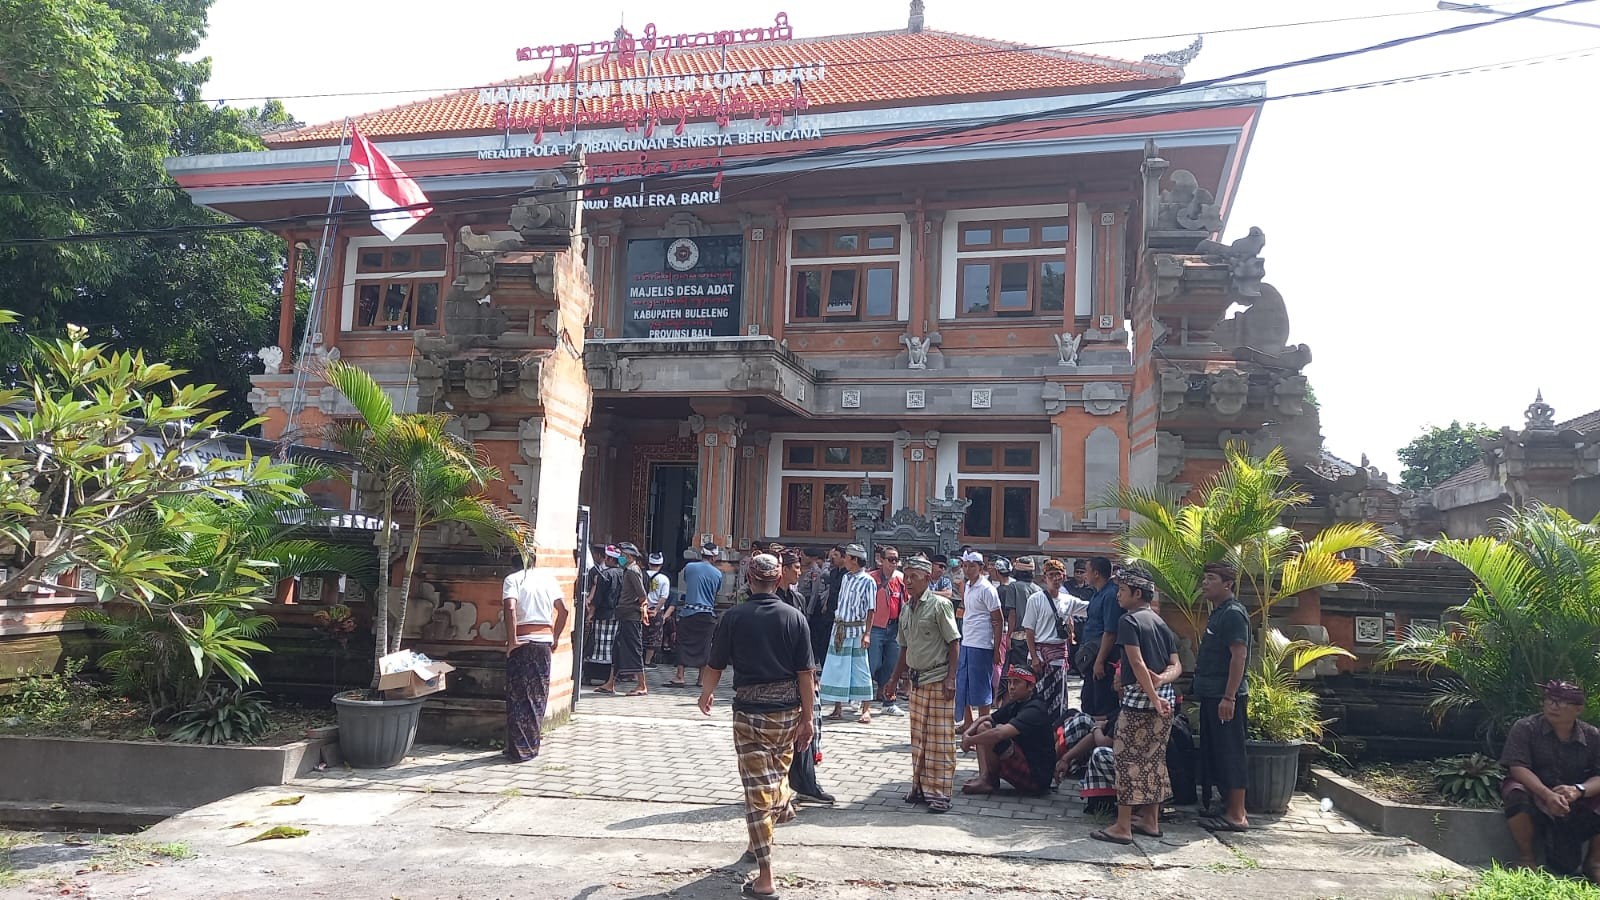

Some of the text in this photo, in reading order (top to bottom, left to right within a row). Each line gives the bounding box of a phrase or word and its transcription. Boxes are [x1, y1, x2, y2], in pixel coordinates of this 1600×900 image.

[773, 61, 824, 84] BALI
[477, 150, 521, 160] MELALUI
[525, 144, 560, 157] POLA
[672, 134, 732, 148] SEMESTA
[738, 127, 821, 144] BERENCANA
[583, 191, 720, 210] NUJU BALI ERA BARU
[630, 284, 735, 298] MAJELIS DESA ADAT
[633, 308, 729, 320] KABUPATEN BULELENG
[649, 328, 712, 339] PROVINSI BALI
